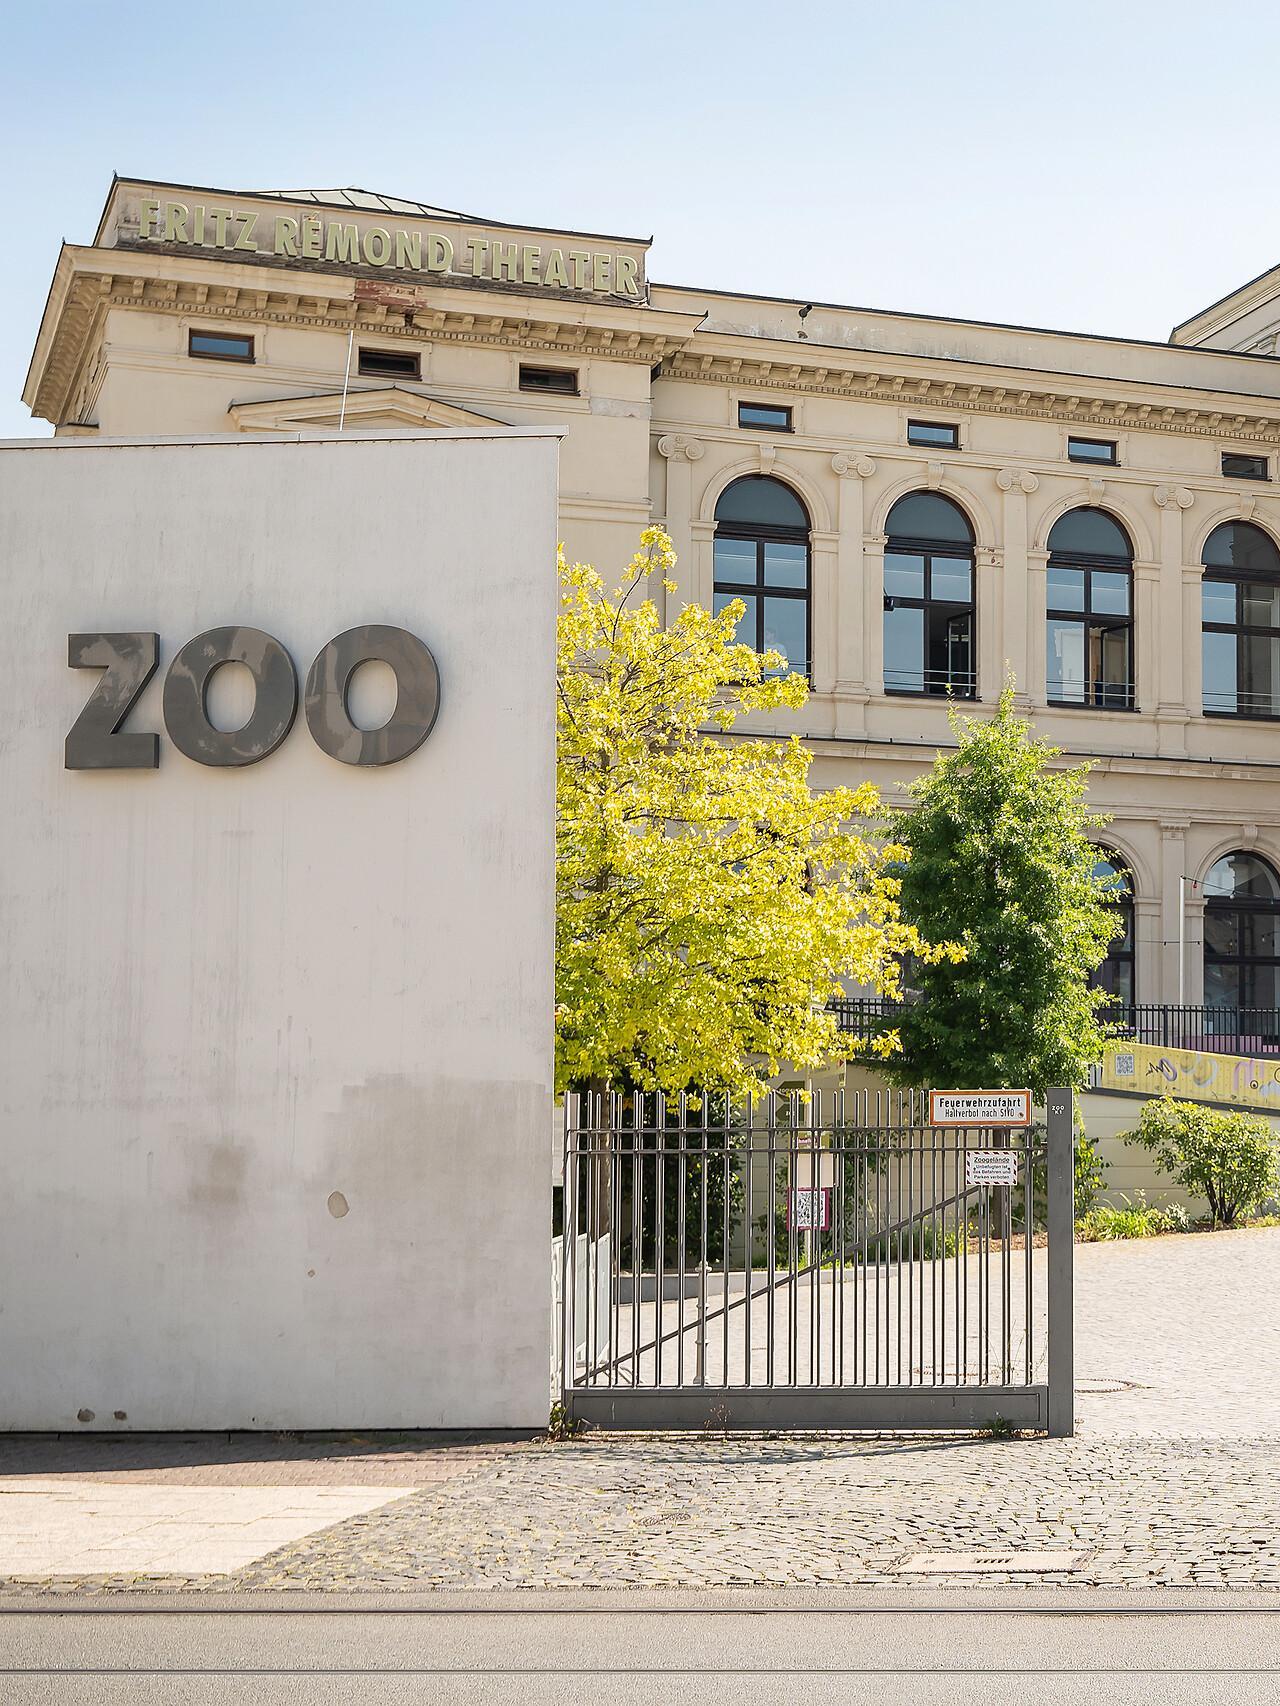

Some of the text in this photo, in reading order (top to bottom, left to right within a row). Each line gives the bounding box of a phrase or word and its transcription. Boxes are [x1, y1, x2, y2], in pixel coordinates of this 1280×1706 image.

[139, 199, 641, 294] FRITZ RÉMOND THEATER
[64, 623, 441, 770] ZOO
[939, 1097, 1021, 1108] Feuerwehrzufahrt
[981, 1109, 997, 1118] nach
